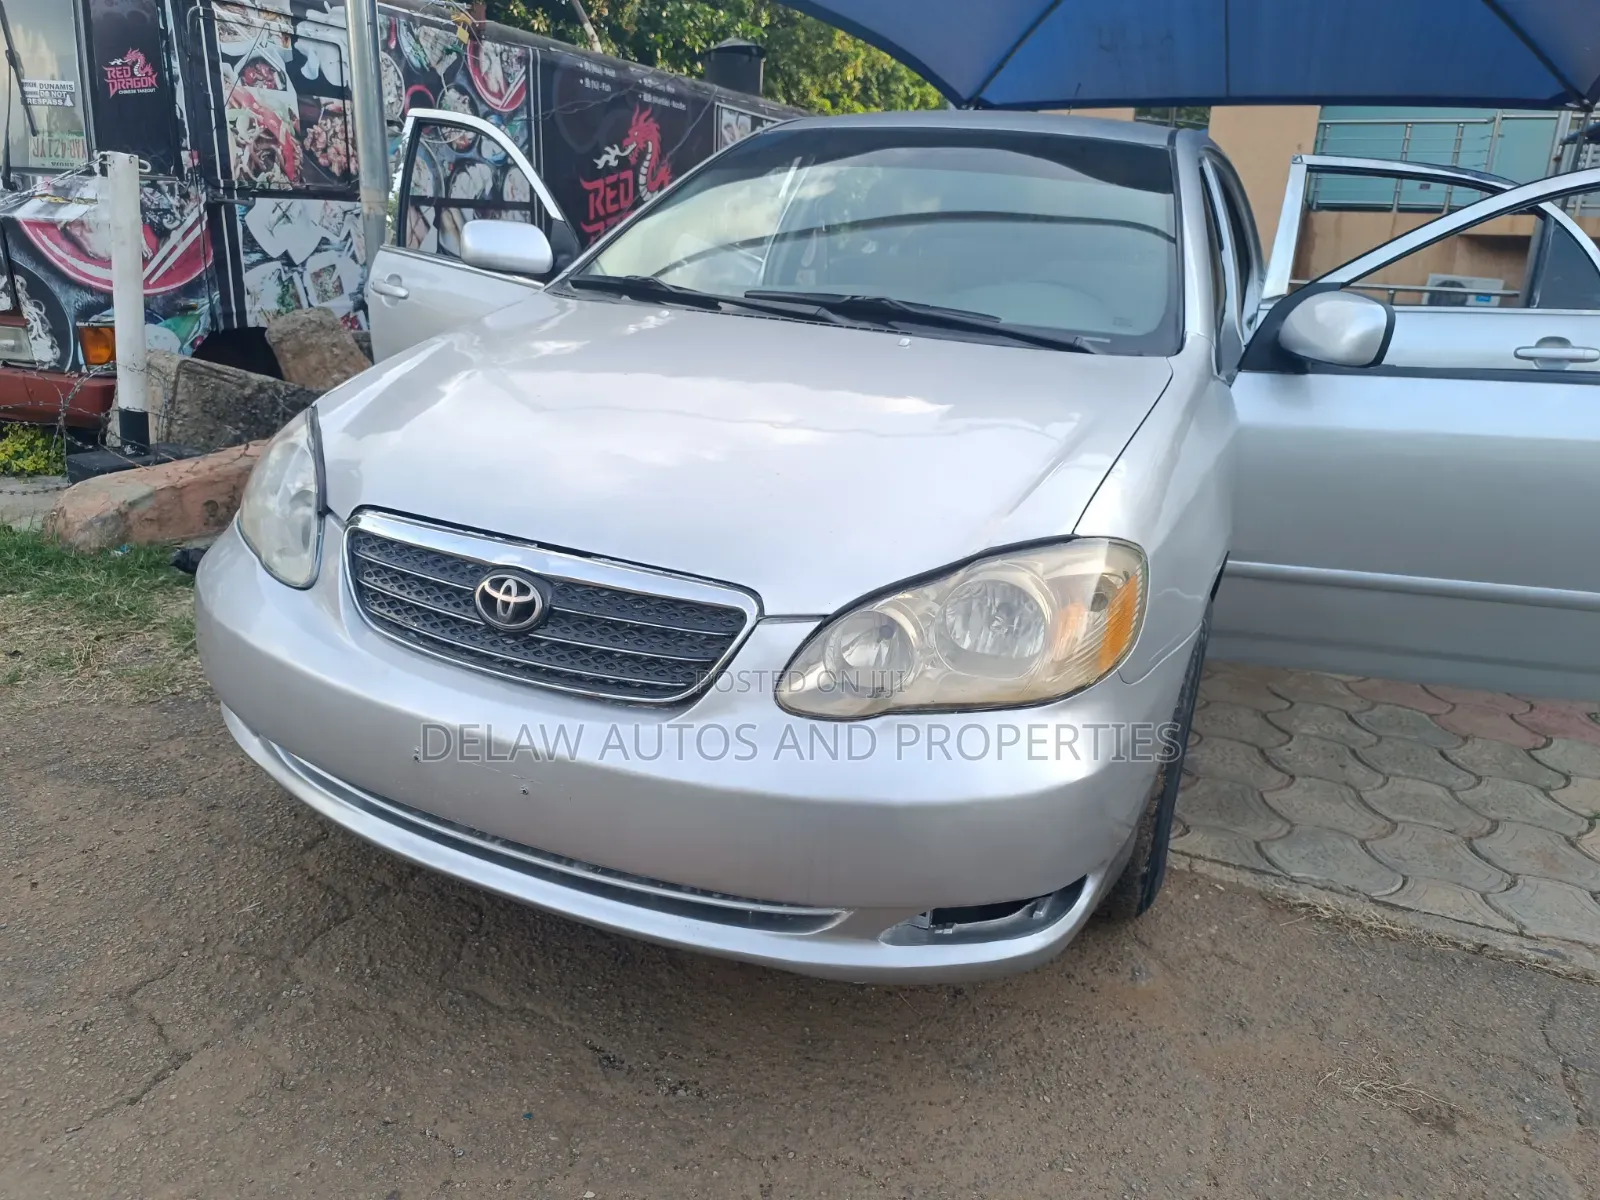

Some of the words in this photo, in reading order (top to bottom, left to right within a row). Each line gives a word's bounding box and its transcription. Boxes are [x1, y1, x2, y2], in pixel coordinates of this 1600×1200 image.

[102, 65, 131, 79] RED
[39, 83, 74, 91] DUNAMIS
[104, 72, 159, 98] DRAGON
[25, 97, 64, 106] RESPASS
[580, 169, 634, 221] RED
